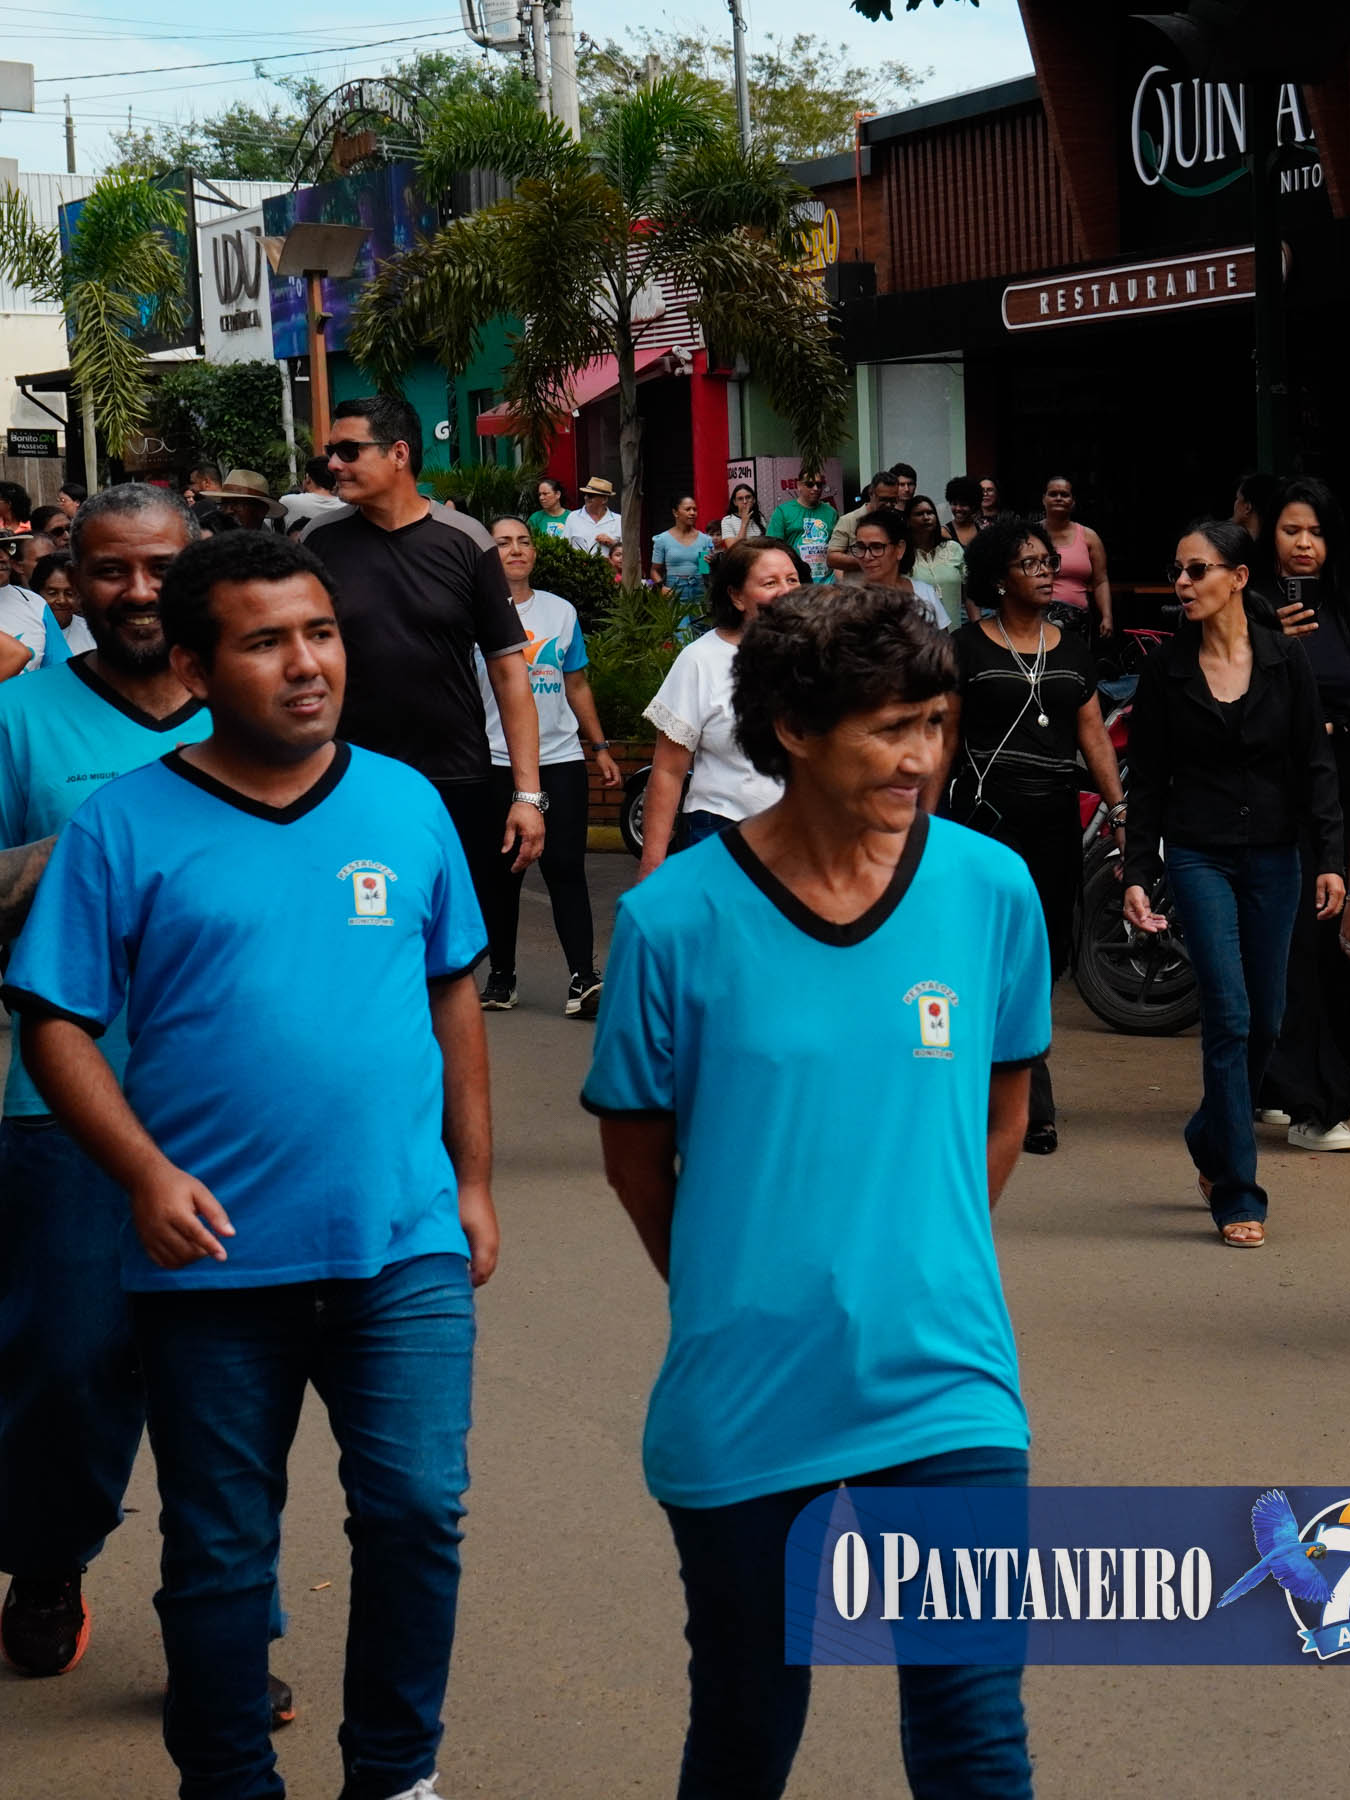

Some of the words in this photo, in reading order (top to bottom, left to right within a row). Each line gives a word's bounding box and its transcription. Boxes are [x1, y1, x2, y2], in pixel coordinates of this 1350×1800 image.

[1131, 65, 1317, 186] QUINA
[1280, 163, 1322, 194] NITO
[1039, 263, 1238, 315] RESTAURANTE
[10, 434, 39, 443] Bonito
